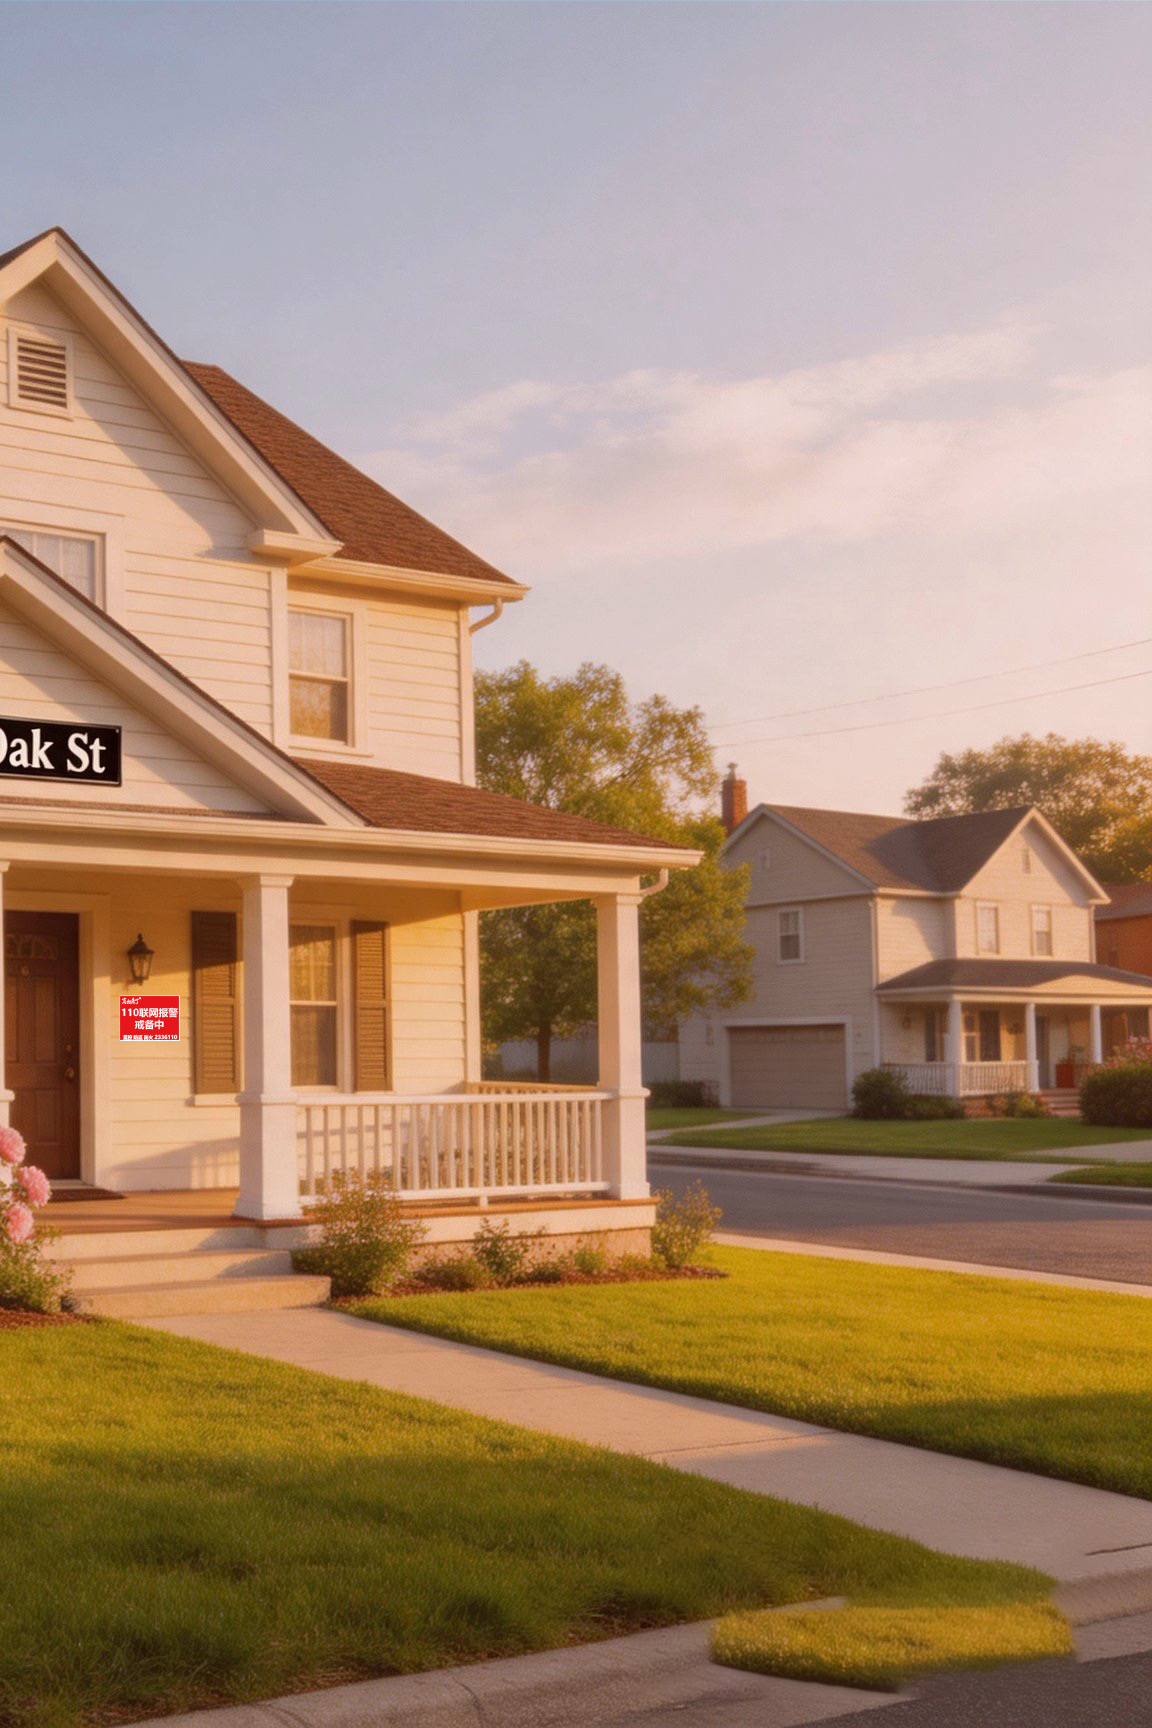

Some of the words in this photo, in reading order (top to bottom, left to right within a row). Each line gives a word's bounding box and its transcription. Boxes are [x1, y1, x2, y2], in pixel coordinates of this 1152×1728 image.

[66, 732, 107, 774] St
[121, 1007, 178, 1018] 110联网报警
[134, 1019, 165, 1030] 戒备中
